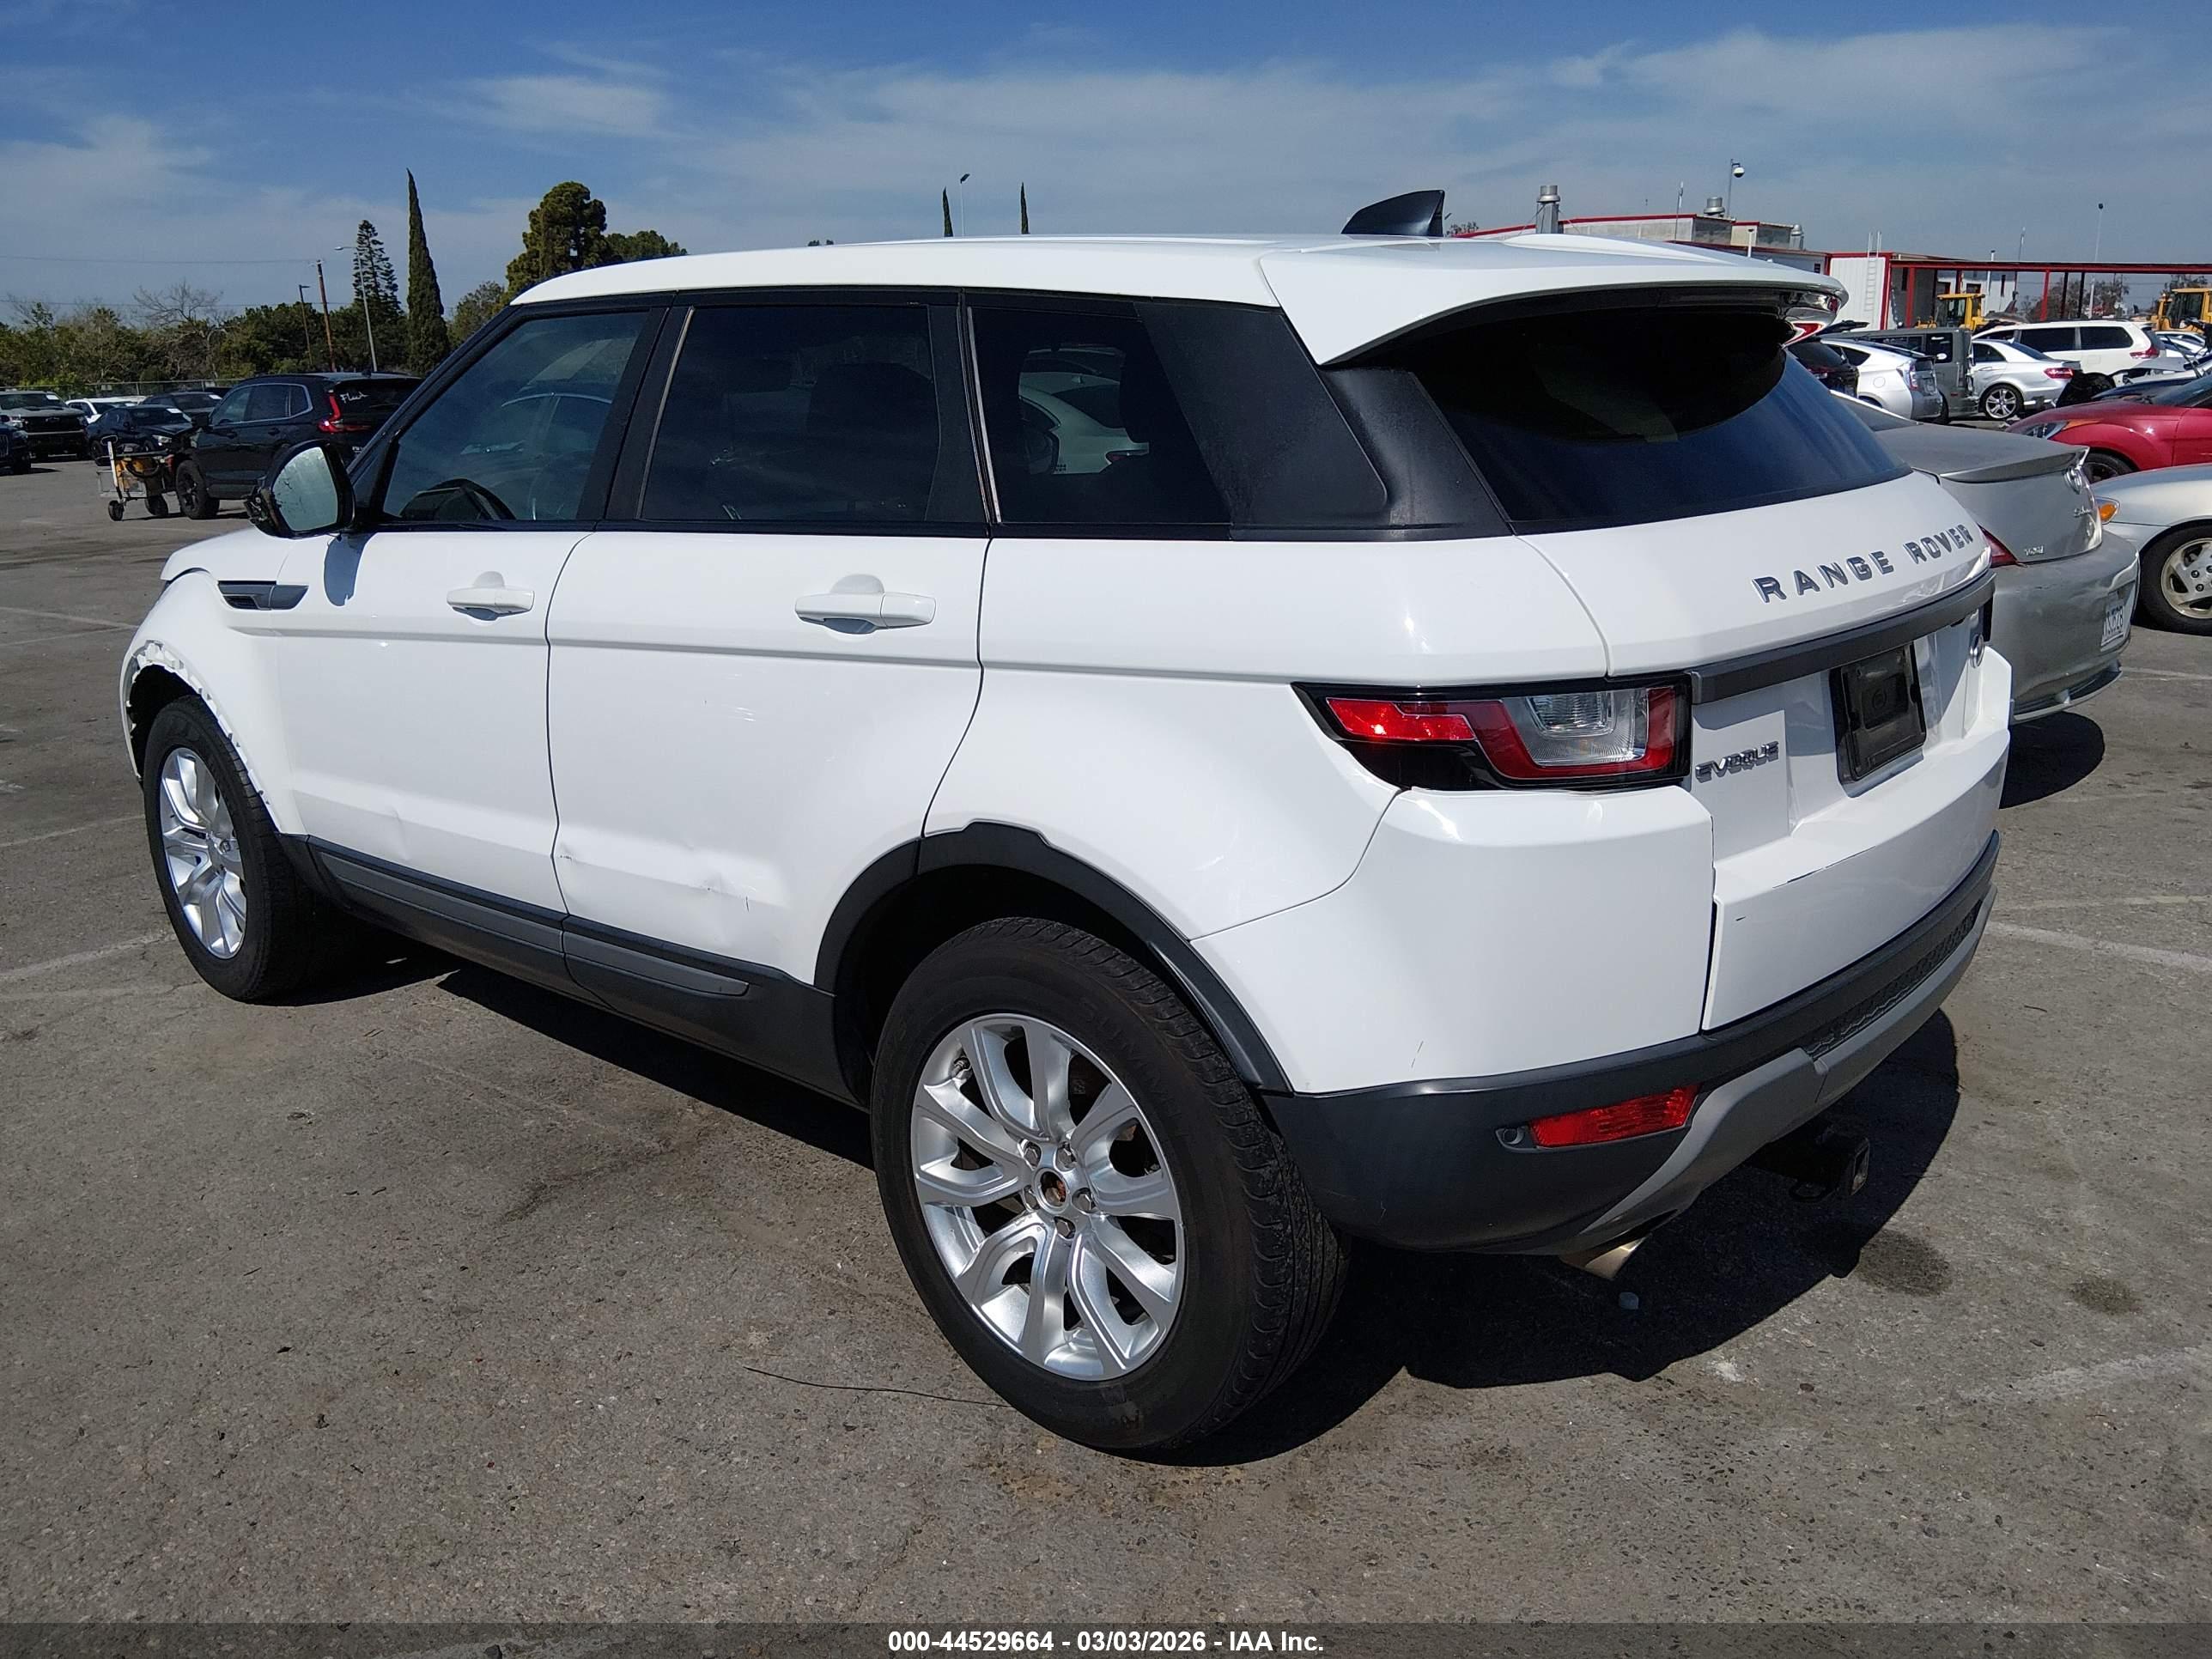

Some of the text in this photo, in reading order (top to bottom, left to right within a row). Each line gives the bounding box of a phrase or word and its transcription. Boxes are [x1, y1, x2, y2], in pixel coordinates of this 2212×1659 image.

[1752, 524, 1974, 604] RANGE ROVER
[1694, 740, 1779, 781] EVOQUE
